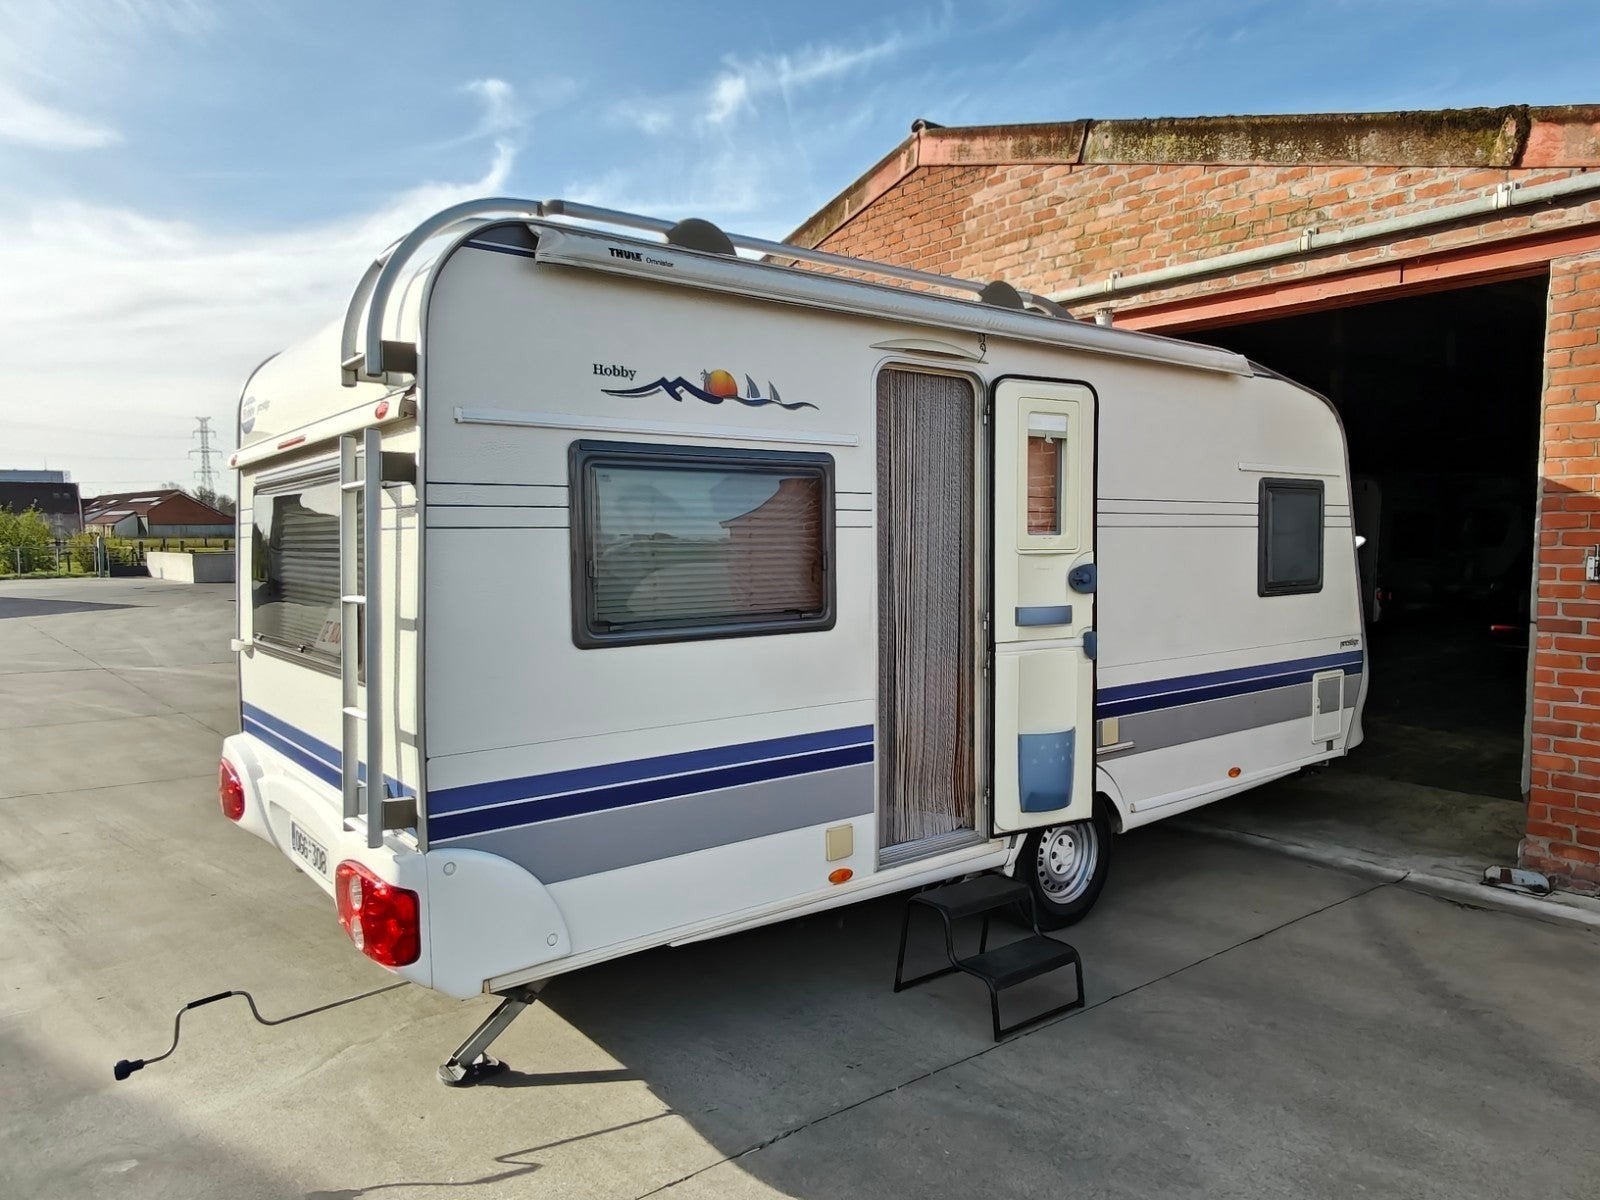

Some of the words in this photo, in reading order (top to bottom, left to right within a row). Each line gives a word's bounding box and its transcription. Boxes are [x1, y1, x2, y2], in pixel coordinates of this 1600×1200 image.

[608, 247, 643, 262] THULE
[645, 257, 675, 268] Omnistor
[592, 363, 637, 381] Hobby
